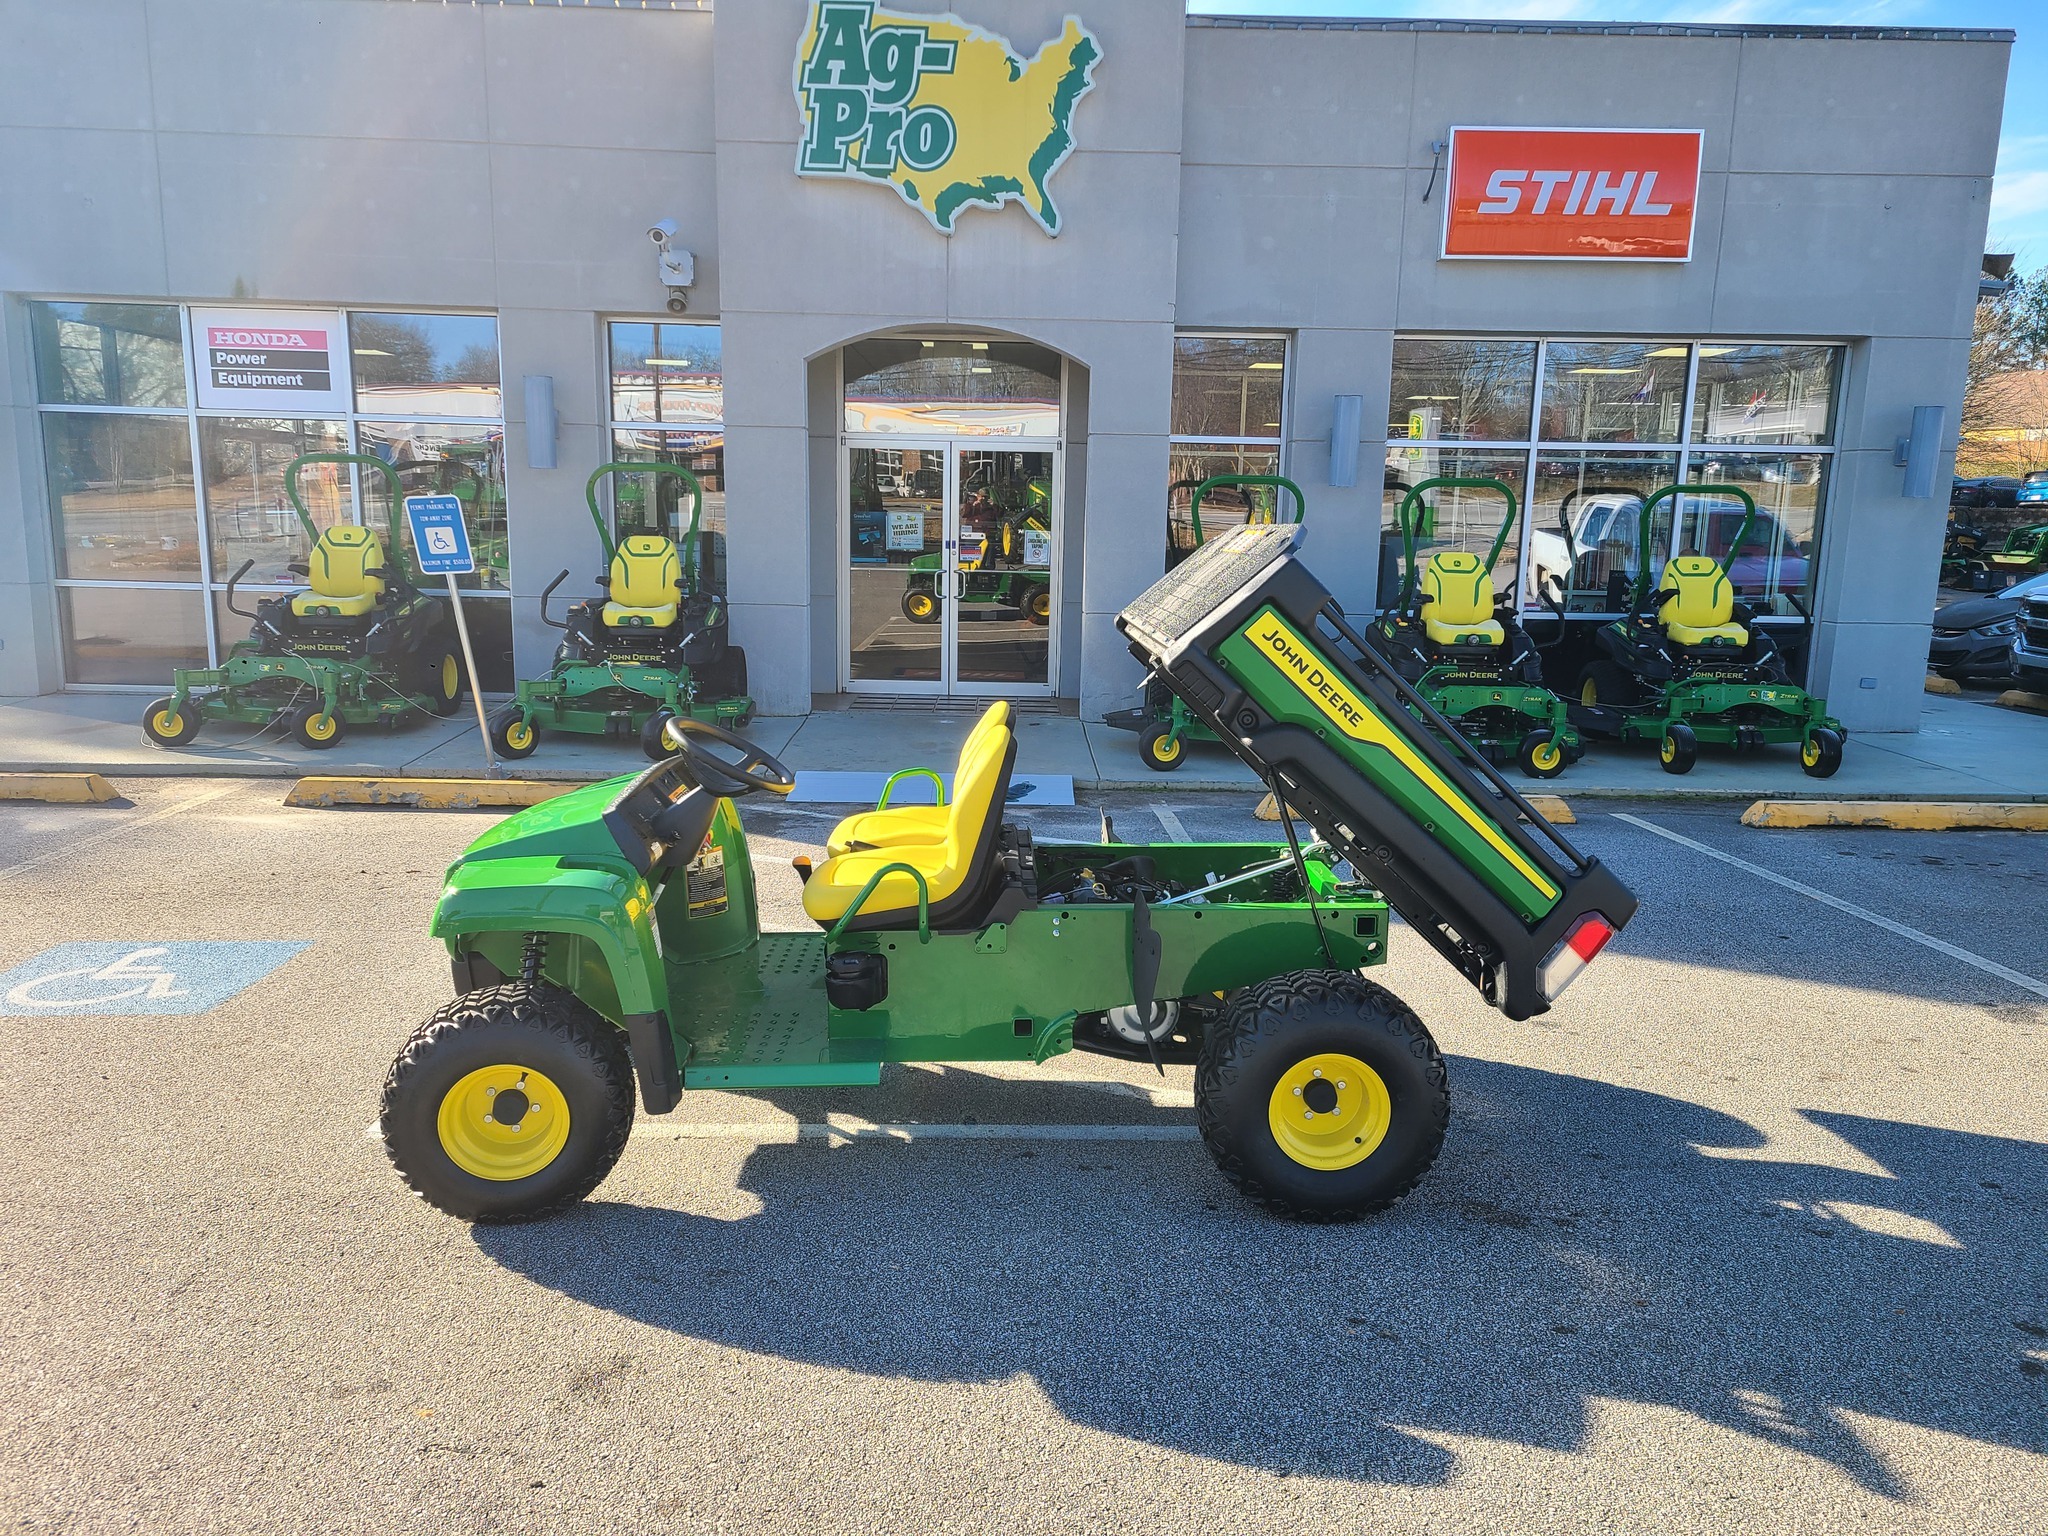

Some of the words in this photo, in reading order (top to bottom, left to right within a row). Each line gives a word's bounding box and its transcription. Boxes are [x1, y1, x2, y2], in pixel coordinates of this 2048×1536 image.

[800, 0, 957, 107] Ag-
[801, 86, 957, 172] Pro
[1477, 169, 1673, 216] STIHL
[214, 331, 307, 347] HONDA
[216, 352, 267, 365] Power
[217, 371, 304, 387] Equipment
[292, 643, 316, 651] JOHN
[317, 643, 347, 651] DEERE
[607, 653, 631, 661] JOHN
[632, 653, 662, 661] DEERE
[1261, 629, 1310, 675] JOHN
[1306, 668, 1364, 728] DEERE
[1469, 671, 1499, 679] DEERE
[1715, 671, 1744, 679] DEERE
